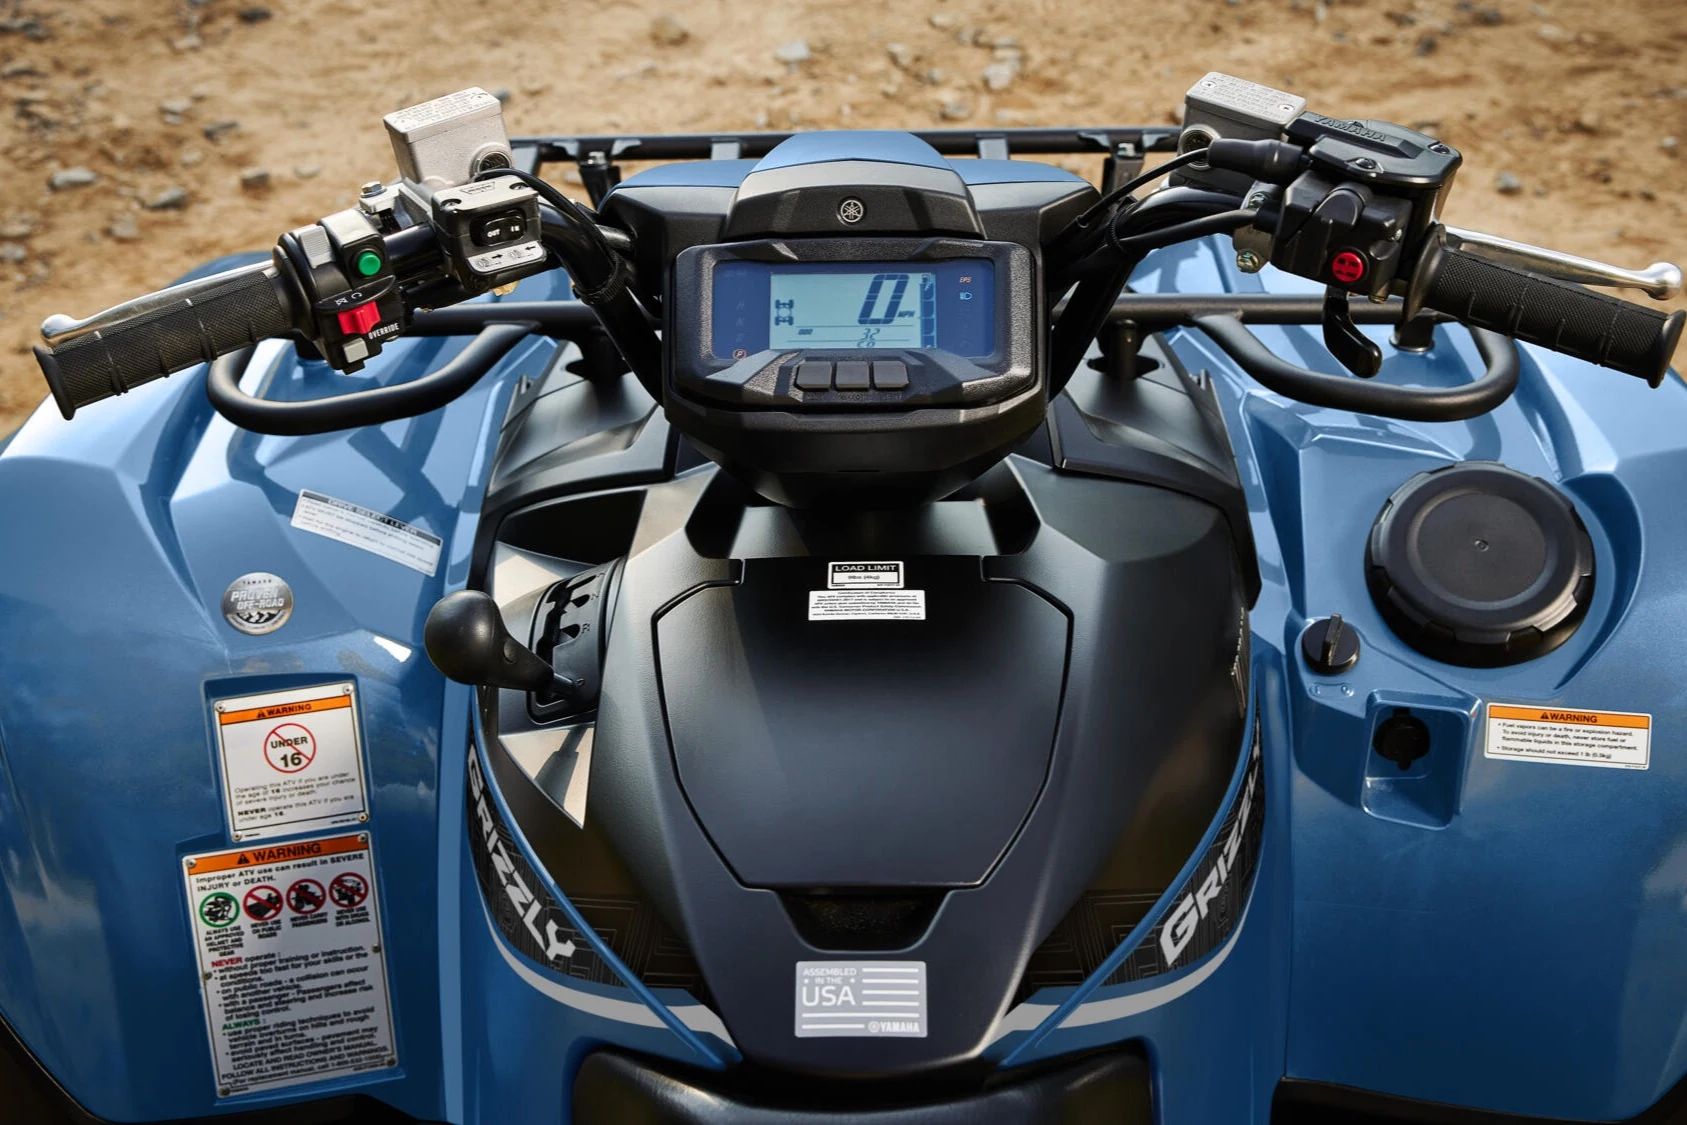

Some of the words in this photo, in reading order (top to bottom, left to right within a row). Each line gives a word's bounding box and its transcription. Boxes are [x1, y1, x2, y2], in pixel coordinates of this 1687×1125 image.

[1315, 117, 1386, 142] YAMAHA
[858, 274, 910, 325] 0
[368, 322, 400, 340] OVERRIDE
[236, 598, 284, 611] OFF-ROAD
[267, 703, 311, 715] WARNING
[1549, 712, 1597, 722] WARNING
[270, 736, 308, 748] UNDER
[280, 752, 302, 768] 16
[237, 807, 265, 816] NEVER
[253, 842, 321, 862] WARNING
[468, 744, 576, 961] GRIZZLY
[195, 871, 235, 884] Improper
[329, 853, 364, 863] SEVERE
[197, 882, 229, 891] INJURY
[244, 875, 276, 884] DEATH.
[211, 957, 242, 967] NEVER
[803, 968, 857, 976] ASSEMBLED
[802, 985, 856, 1006] USA
[222, 1018, 260, 1030] ALWAYS
[880, 1022, 920, 1032] YAMAHA
[221, 1069, 253, 1080] FOLLOW
[271, 1056, 326, 1071] INSTRUCTIONS
[233, 1060, 262, 1070] LOCATE
